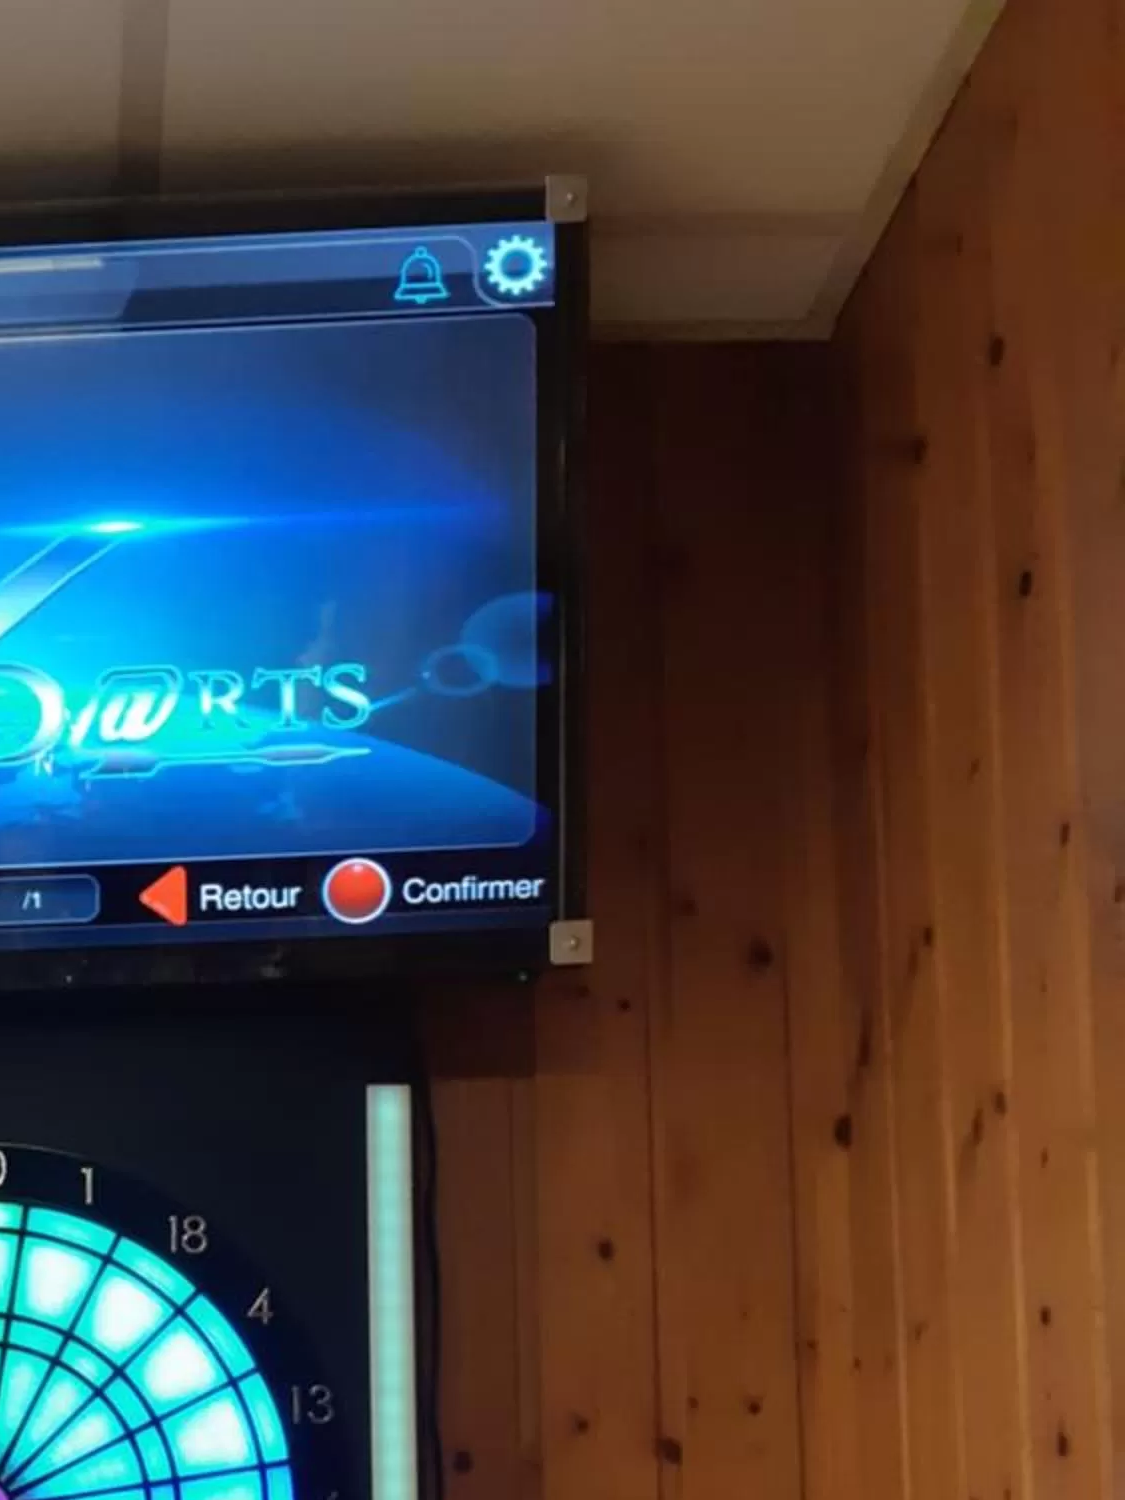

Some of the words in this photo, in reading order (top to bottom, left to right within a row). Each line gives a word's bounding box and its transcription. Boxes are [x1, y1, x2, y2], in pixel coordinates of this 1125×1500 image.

[199, 883, 302, 912] Retour
[402, 876, 544, 905] Confirmer
[80, 1166, 94, 1205] 1
[168, 1214, 209, 1254] 18
[246, 1287, 274, 1325] 4
[291, 1384, 335, 1425] 13
